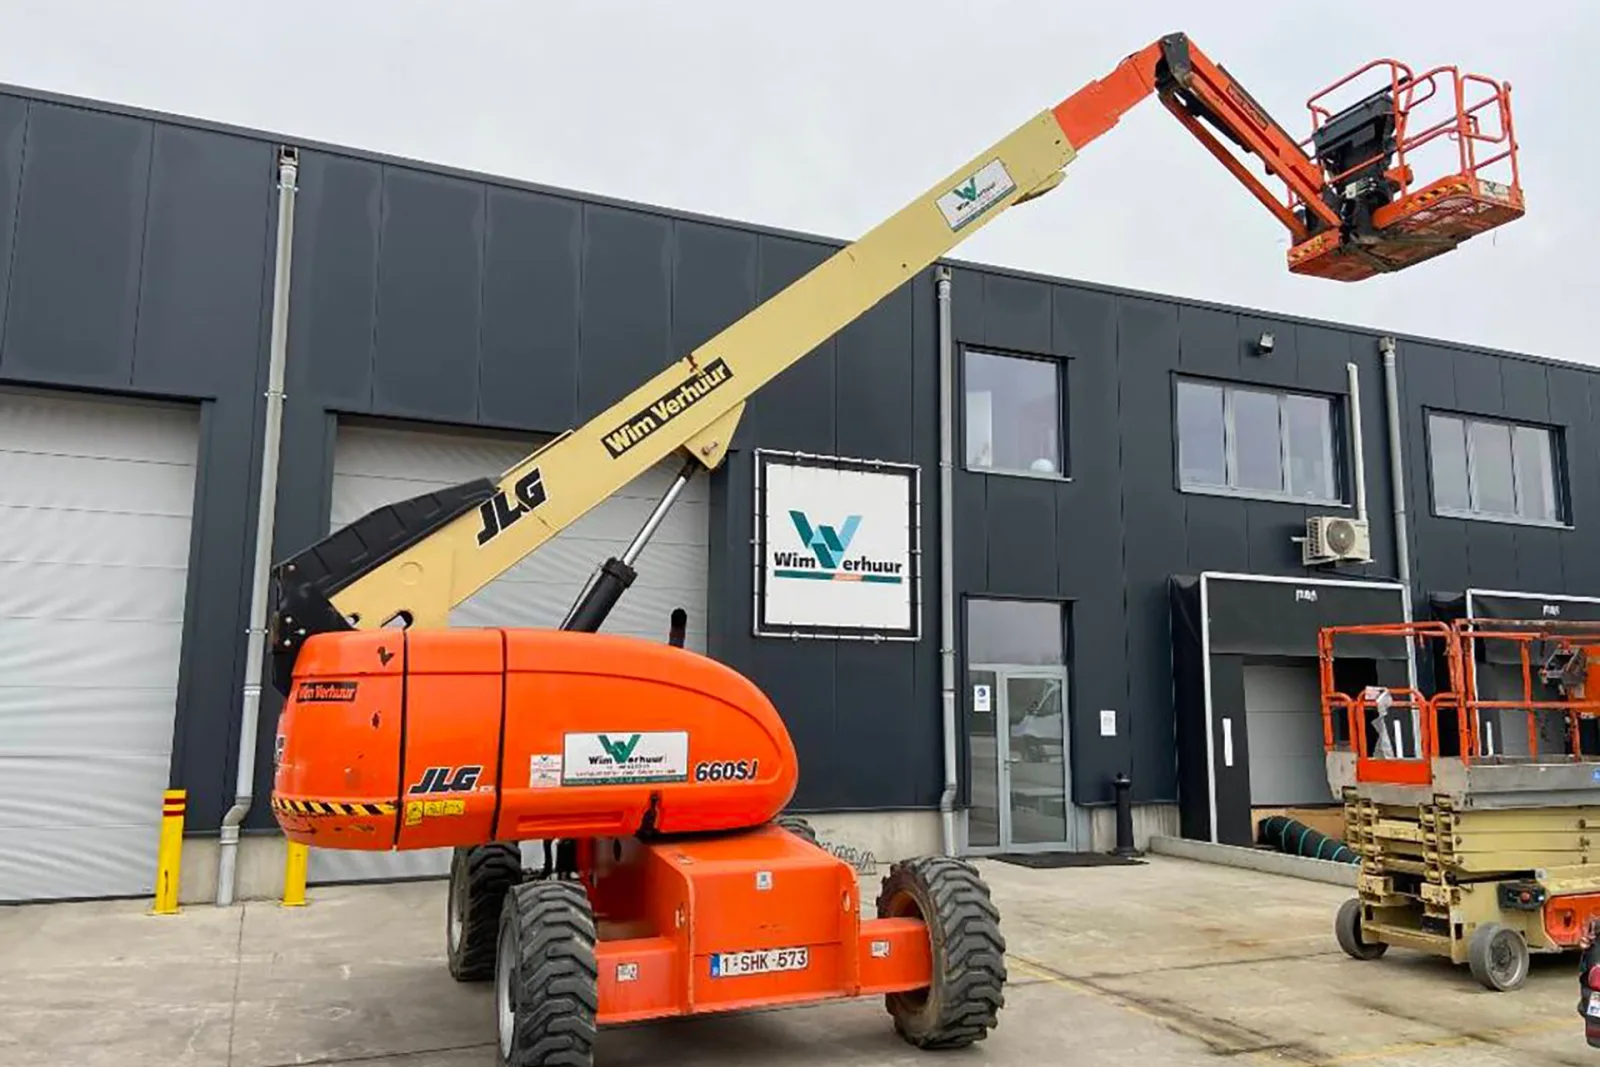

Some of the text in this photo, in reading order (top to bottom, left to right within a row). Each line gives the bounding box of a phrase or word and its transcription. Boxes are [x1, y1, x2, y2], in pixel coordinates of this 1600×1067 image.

[604, 362, 728, 454] Wim Verhuur
[476, 466, 549, 547] JLG
[773, 551, 816, 569] Wim
[588, 755, 613, 765] Wim
[695, 759, 758, 782] 660SJ
[407, 764, 484, 796] JLG
